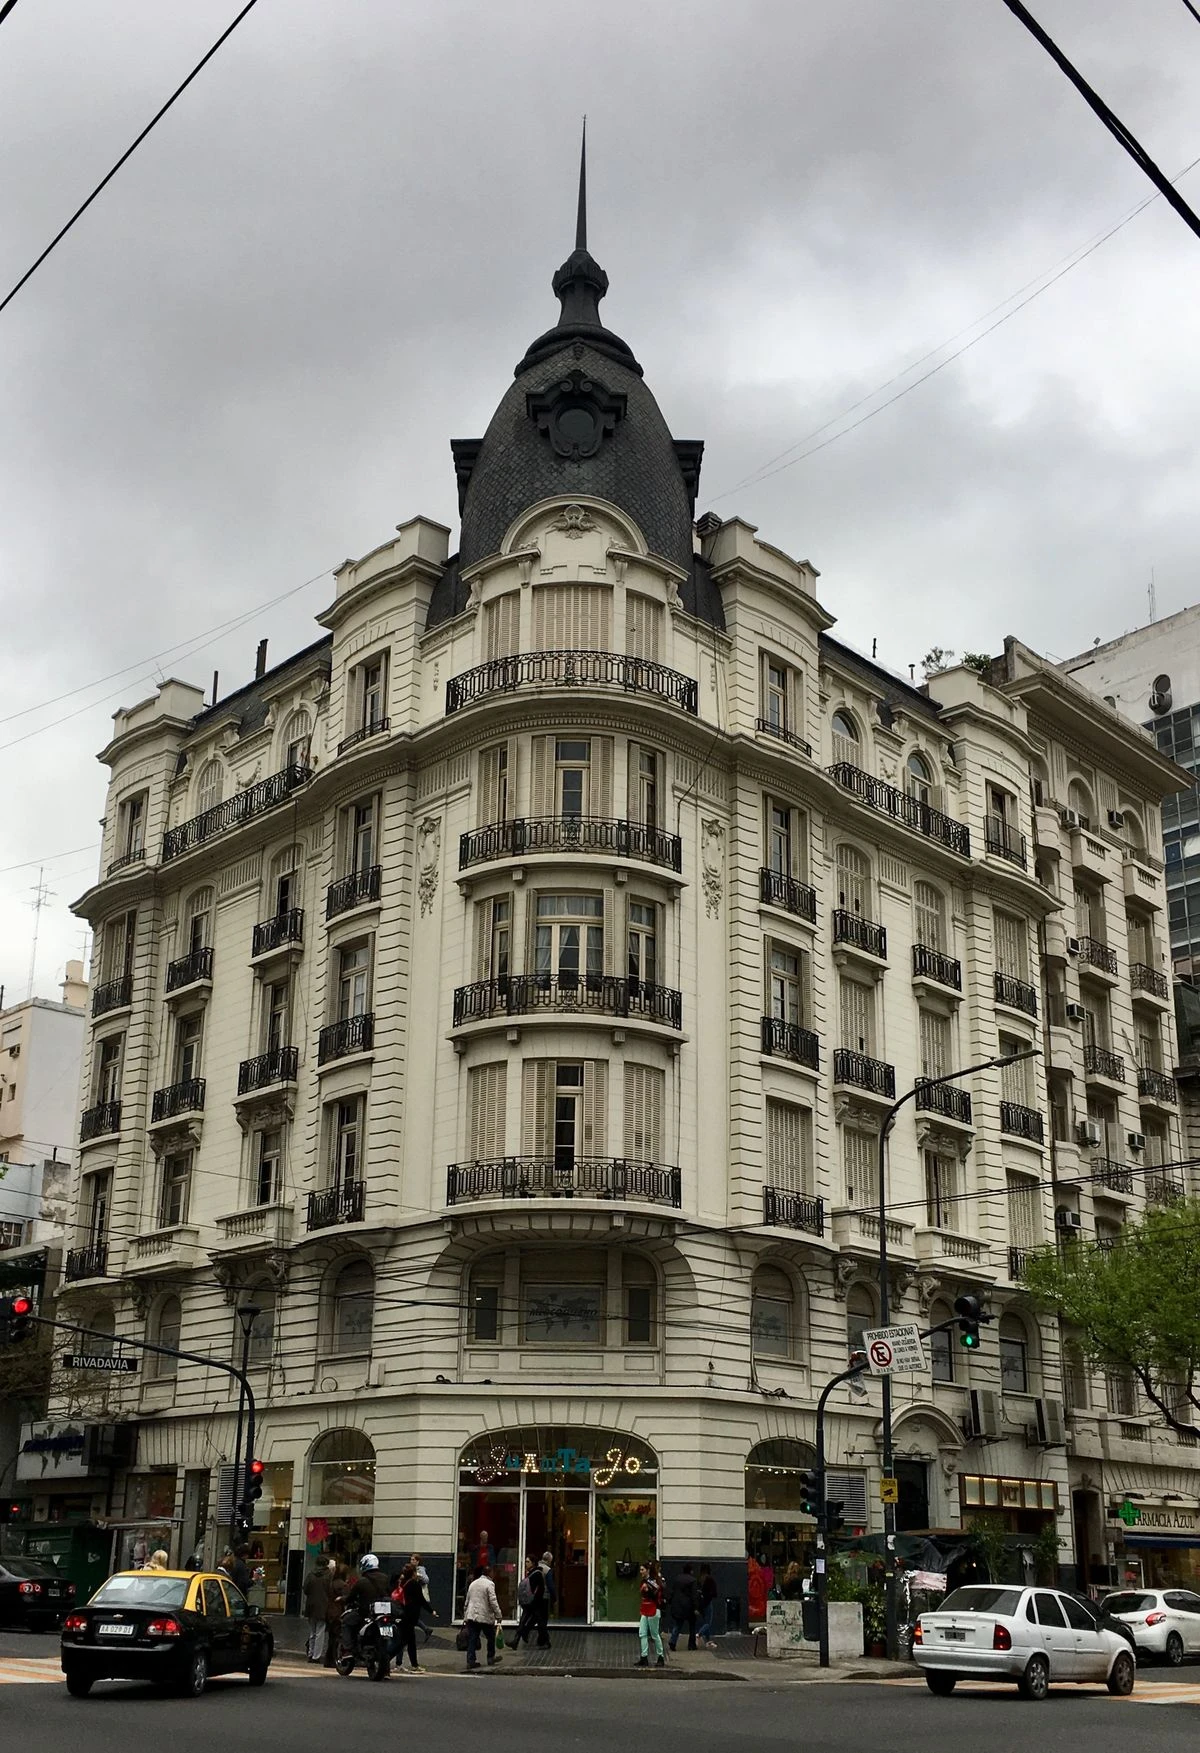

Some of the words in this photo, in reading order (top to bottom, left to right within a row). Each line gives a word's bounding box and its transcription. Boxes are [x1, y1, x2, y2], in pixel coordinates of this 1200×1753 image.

[867, 1330, 888, 1340] PROHIBIDO
[889, 1327, 914, 1338] ESTACIONAR
[72, 1356, 129, 1370] RIVADAVIA
[593, 1447, 640, 1486] Jo
[1134, 1511, 1172, 1528] ARMACIA
